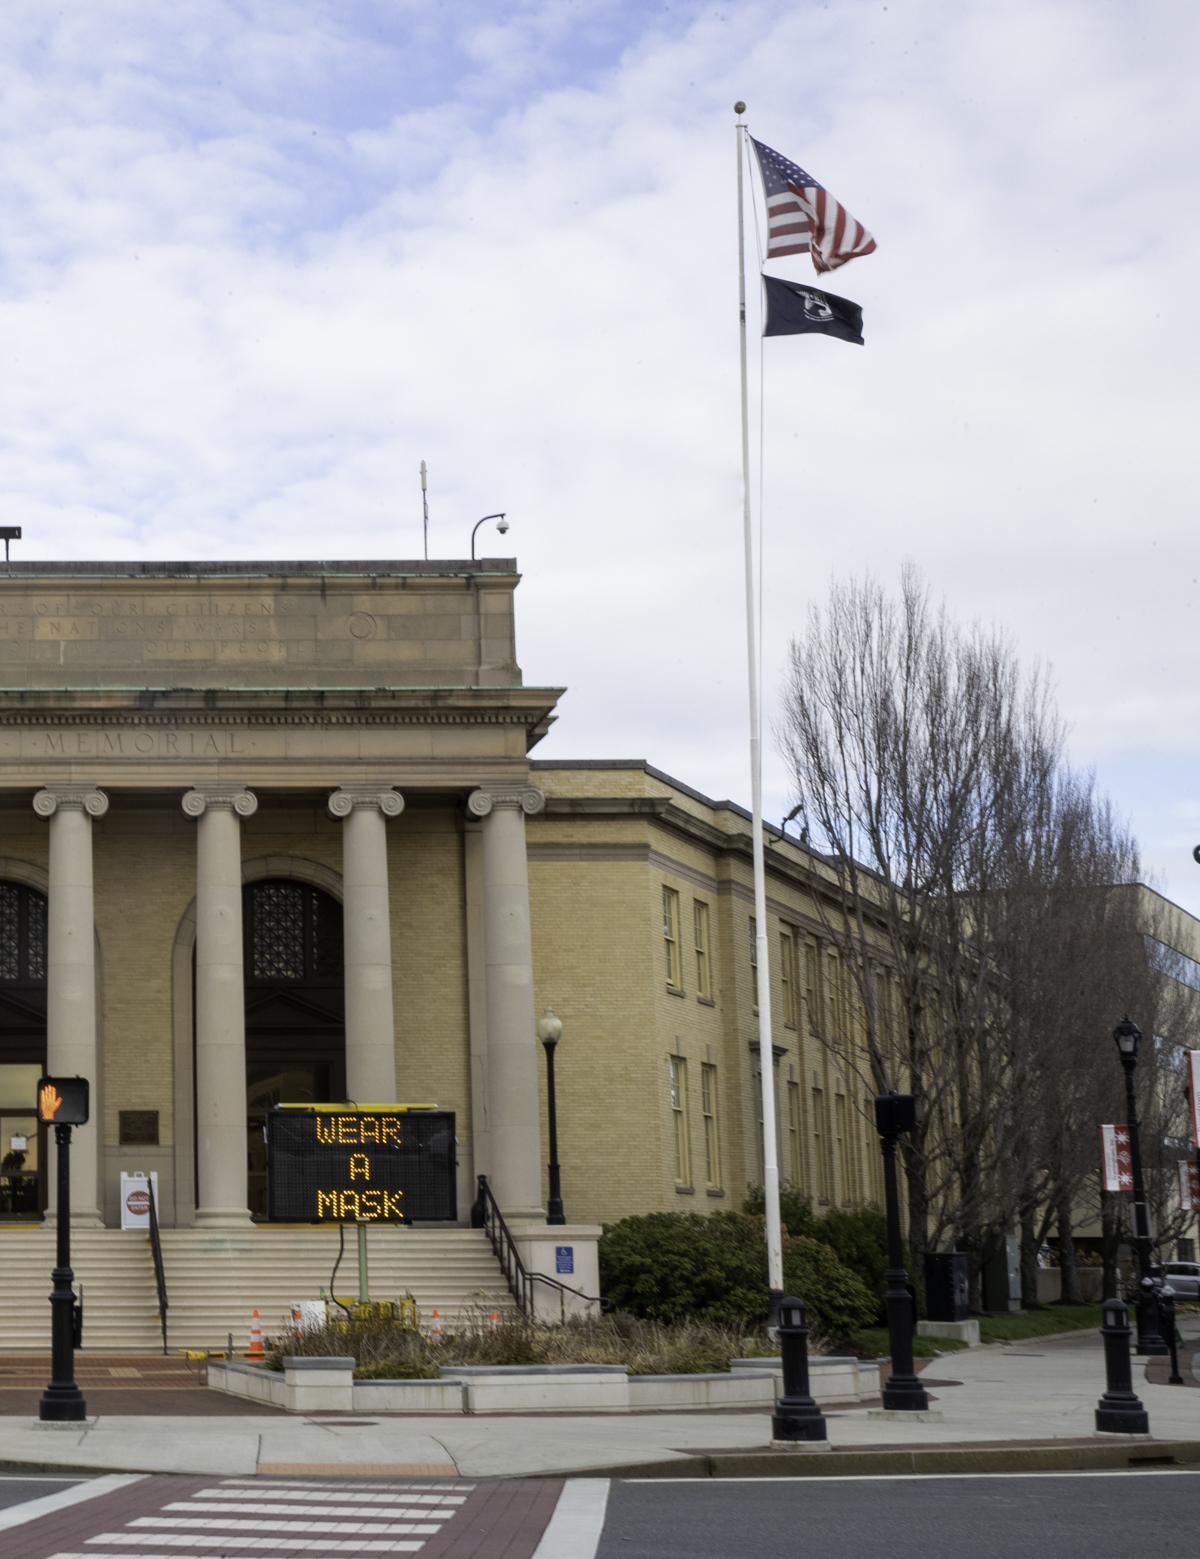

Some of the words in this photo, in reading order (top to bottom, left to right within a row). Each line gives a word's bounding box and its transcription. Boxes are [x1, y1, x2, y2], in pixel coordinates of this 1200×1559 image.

[34, 602, 64, 616] OF
[90, 602, 140, 616] OUR
[165, 602, 288, 616] CITIZENS
[49, 621, 166, 635] NATIONS
[191, 621, 258, 635] WARS
[144, 640, 194, 653] OUR
[219, 640, 327, 653] PEOPLE
[43, 732, 245, 753] MEMORIAL
[316, 1116, 402, 1144] WEAR
[350, 1153, 370, 1181] A
[317, 1190, 404, 1218] MASK
